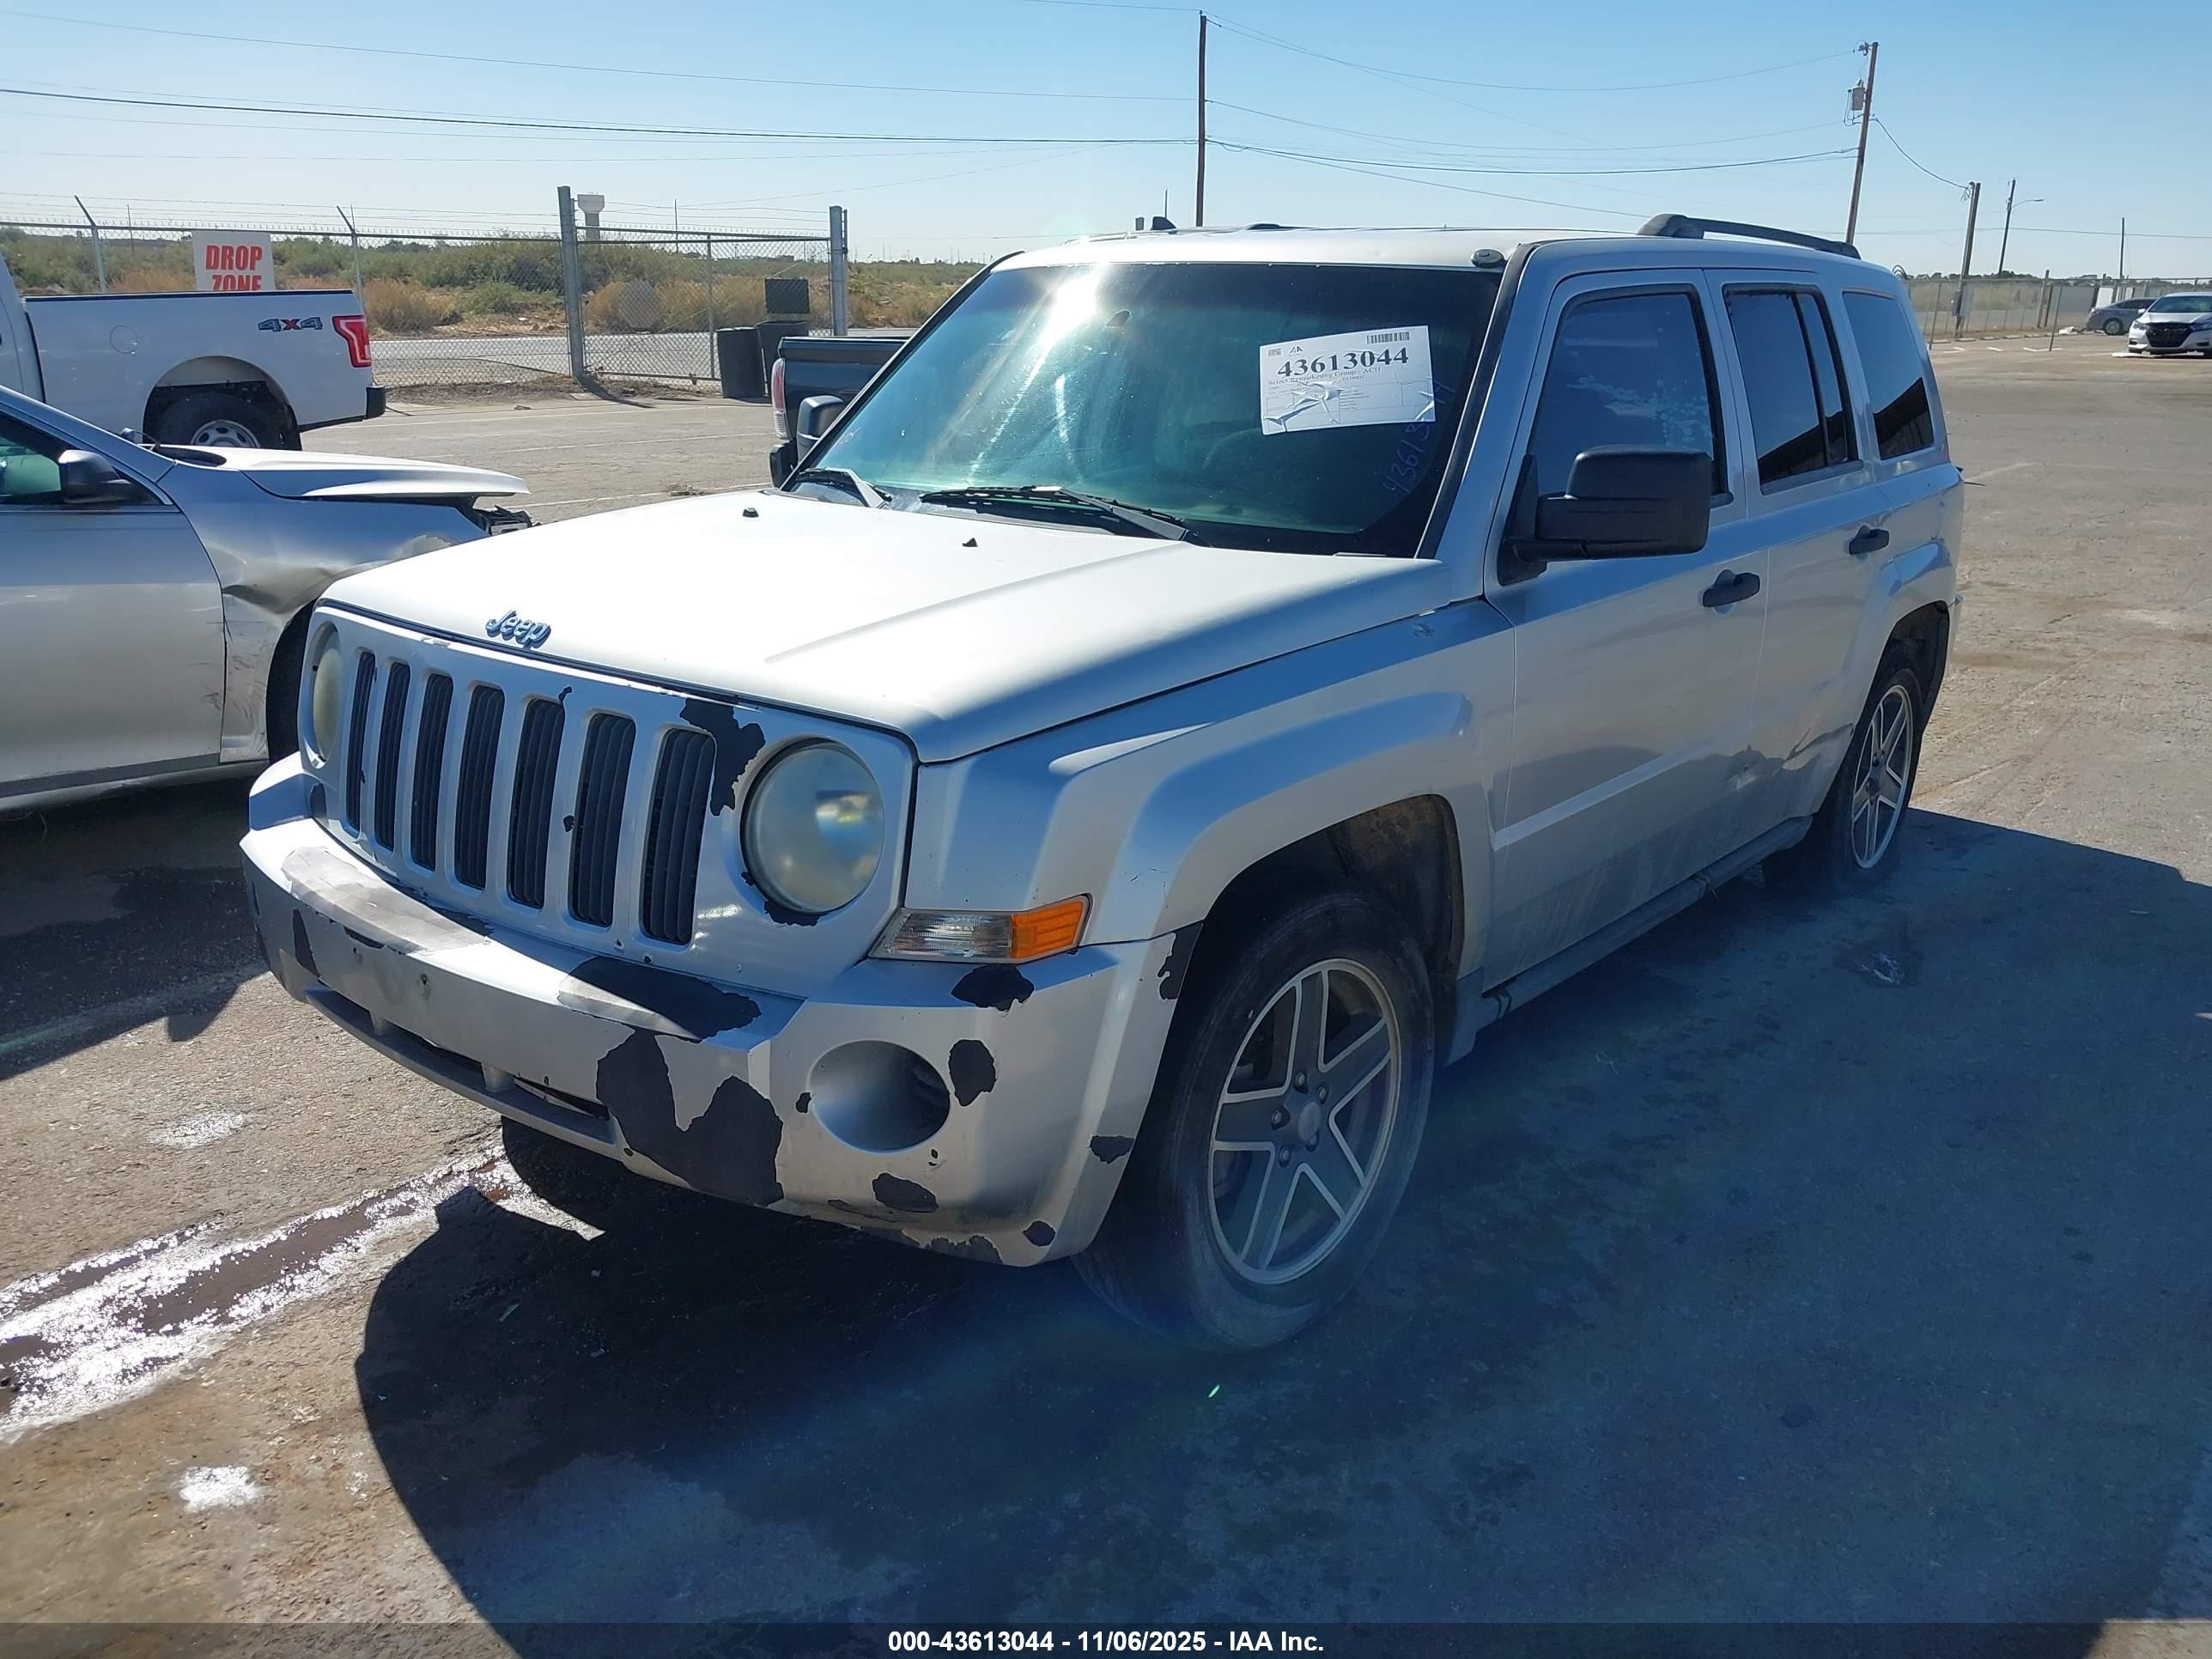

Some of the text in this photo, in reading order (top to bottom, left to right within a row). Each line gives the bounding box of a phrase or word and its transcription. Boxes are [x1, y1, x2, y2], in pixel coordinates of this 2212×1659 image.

[205, 246, 262, 270] DROP
[212, 275, 262, 290] ZONE
[1277, 347, 1409, 377] 43613044
[485, 610, 551, 650] Jeep
